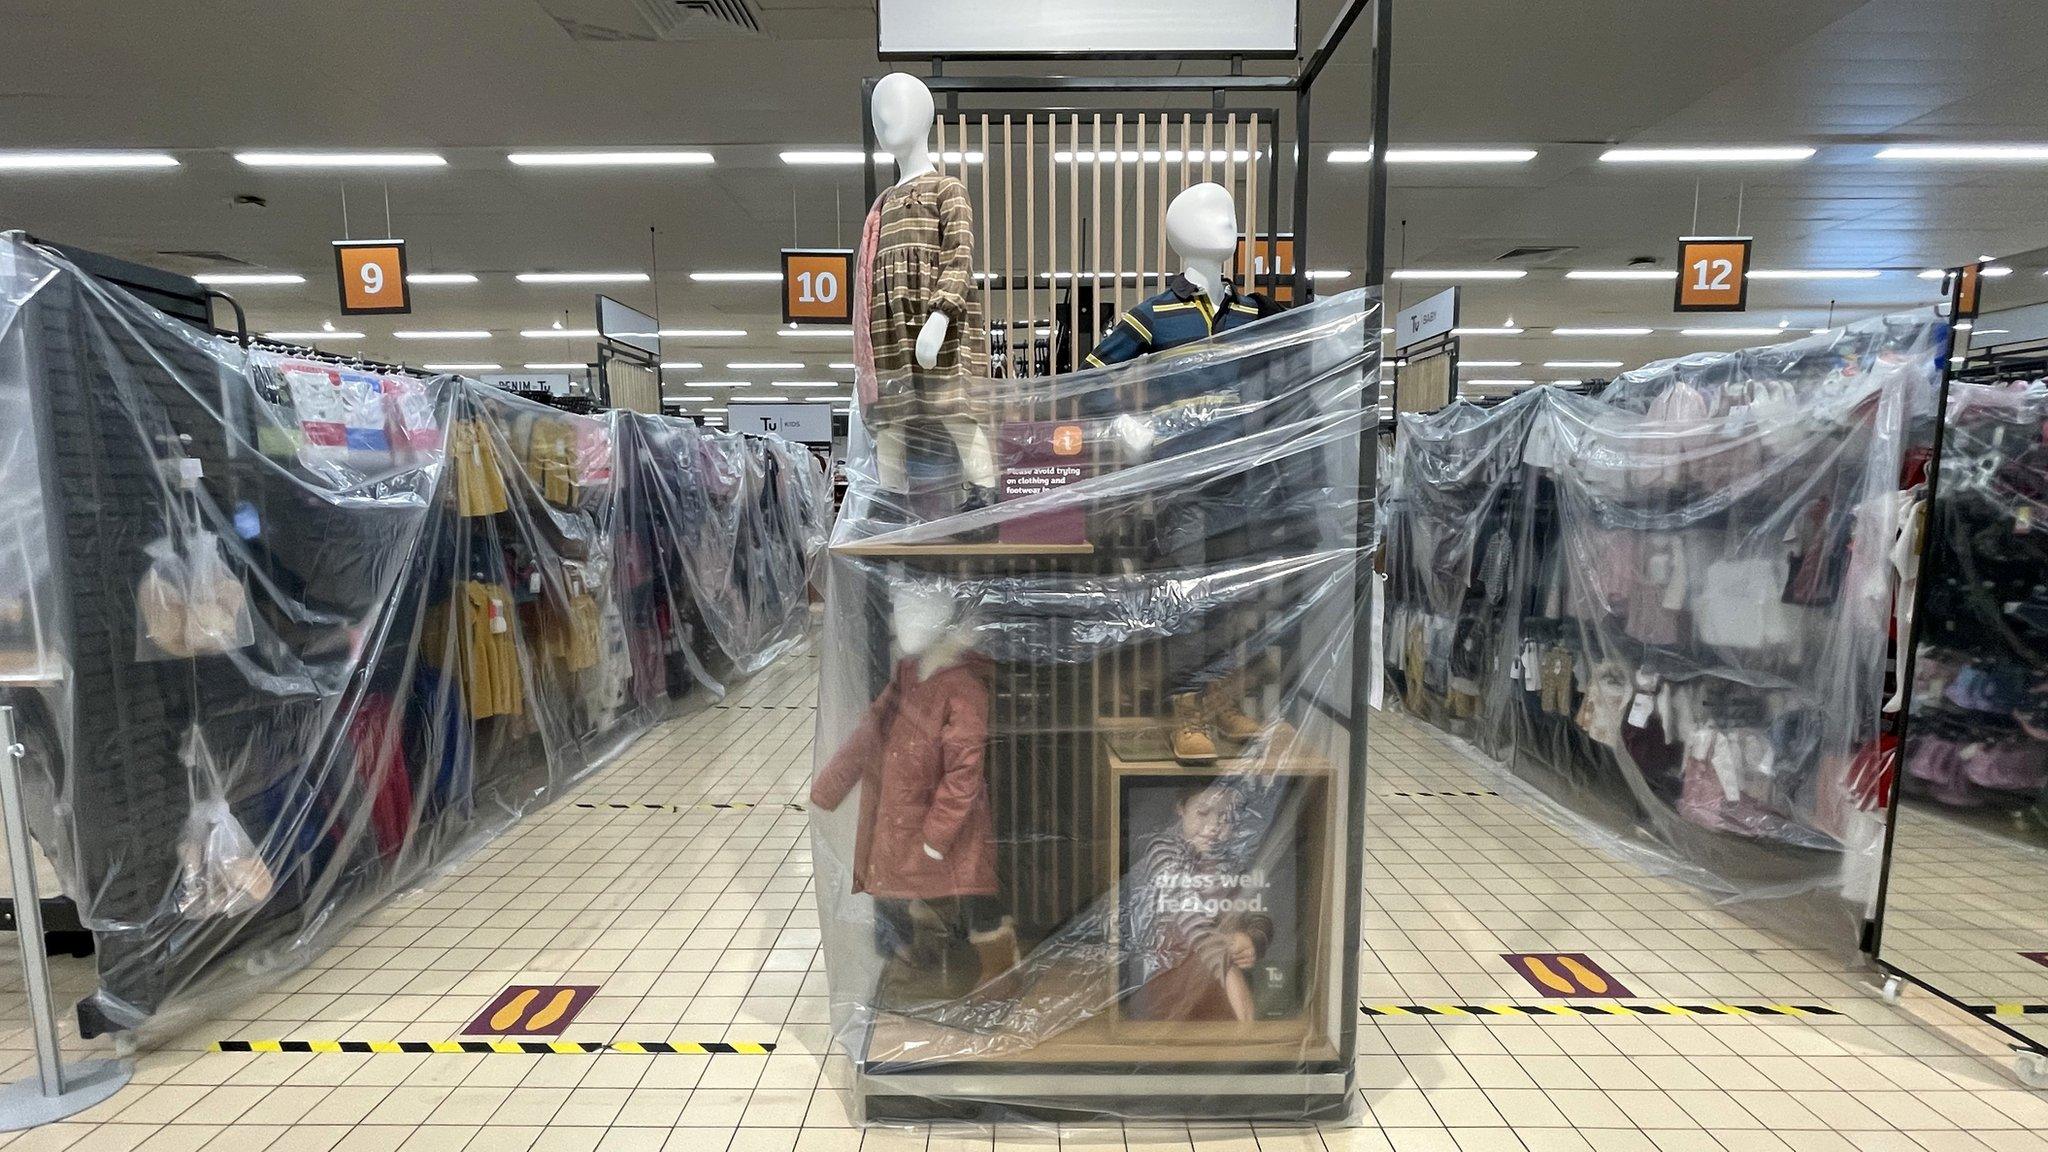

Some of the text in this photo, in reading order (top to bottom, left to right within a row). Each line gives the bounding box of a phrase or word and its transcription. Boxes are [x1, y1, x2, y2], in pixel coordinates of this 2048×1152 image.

[360, 262, 384, 294] 9
[1693, 259, 1733, 290] 12
[797, 271, 838, 303] 10
[537, 380, 551, 391] Tu
[760, 417, 777, 431] Tu
[1034, 467, 1055, 475] avoid
[1056, 467, 1081, 476] trying
[1017, 477, 1050, 486] clothing
[1050, 477, 1066, 485] and
[1006, 486, 1041, 494] footwear
[1155, 868, 1271, 889] dress well.
[1203, 893, 1268, 918] good.
[1265, 966, 1284, 981] Tu
